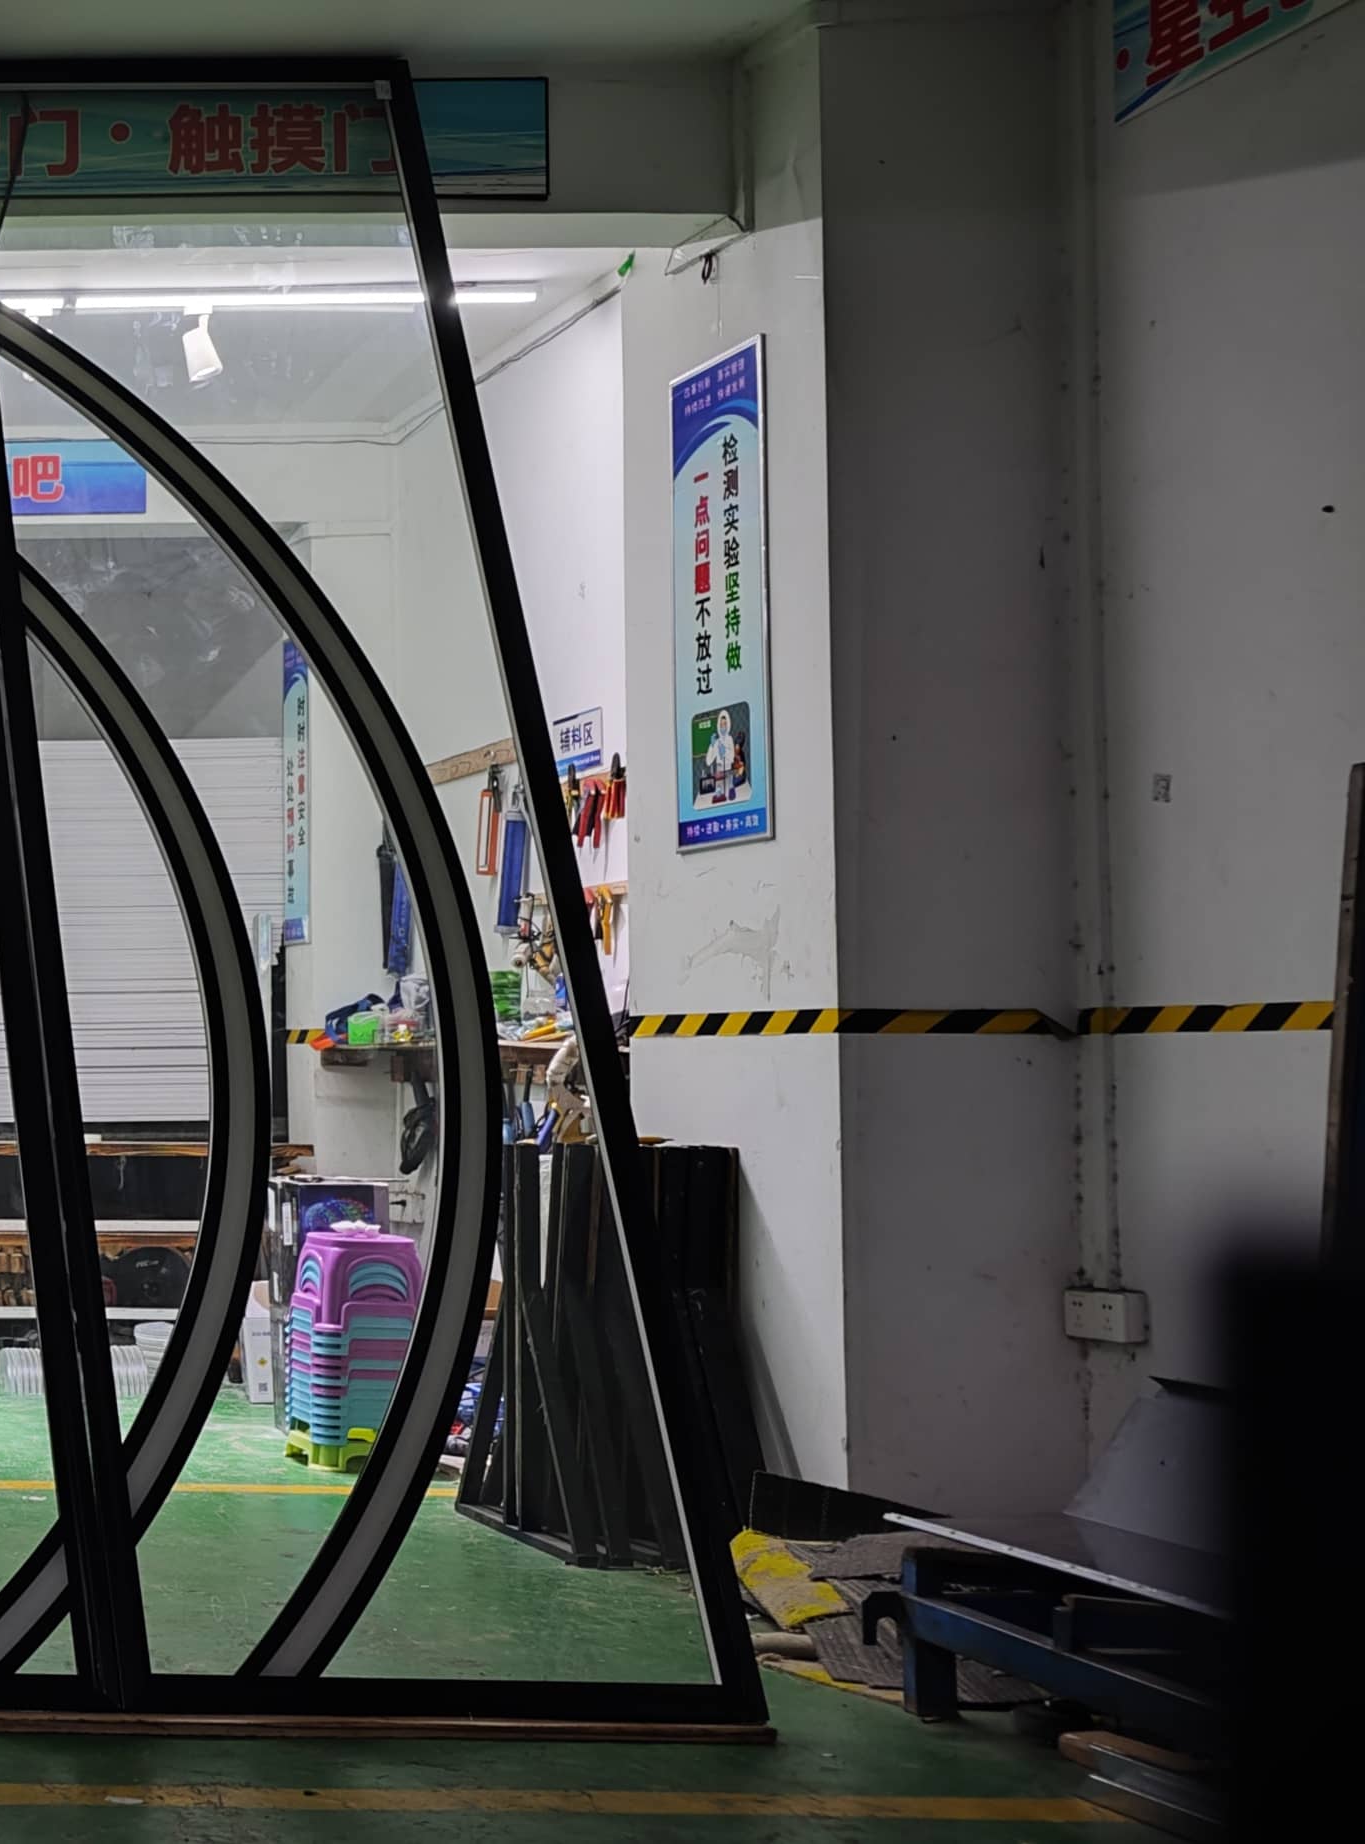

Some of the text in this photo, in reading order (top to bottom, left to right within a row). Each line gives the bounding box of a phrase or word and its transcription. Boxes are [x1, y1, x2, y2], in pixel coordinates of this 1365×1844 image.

[693, 471, 713, 696] 一点问题不放过
